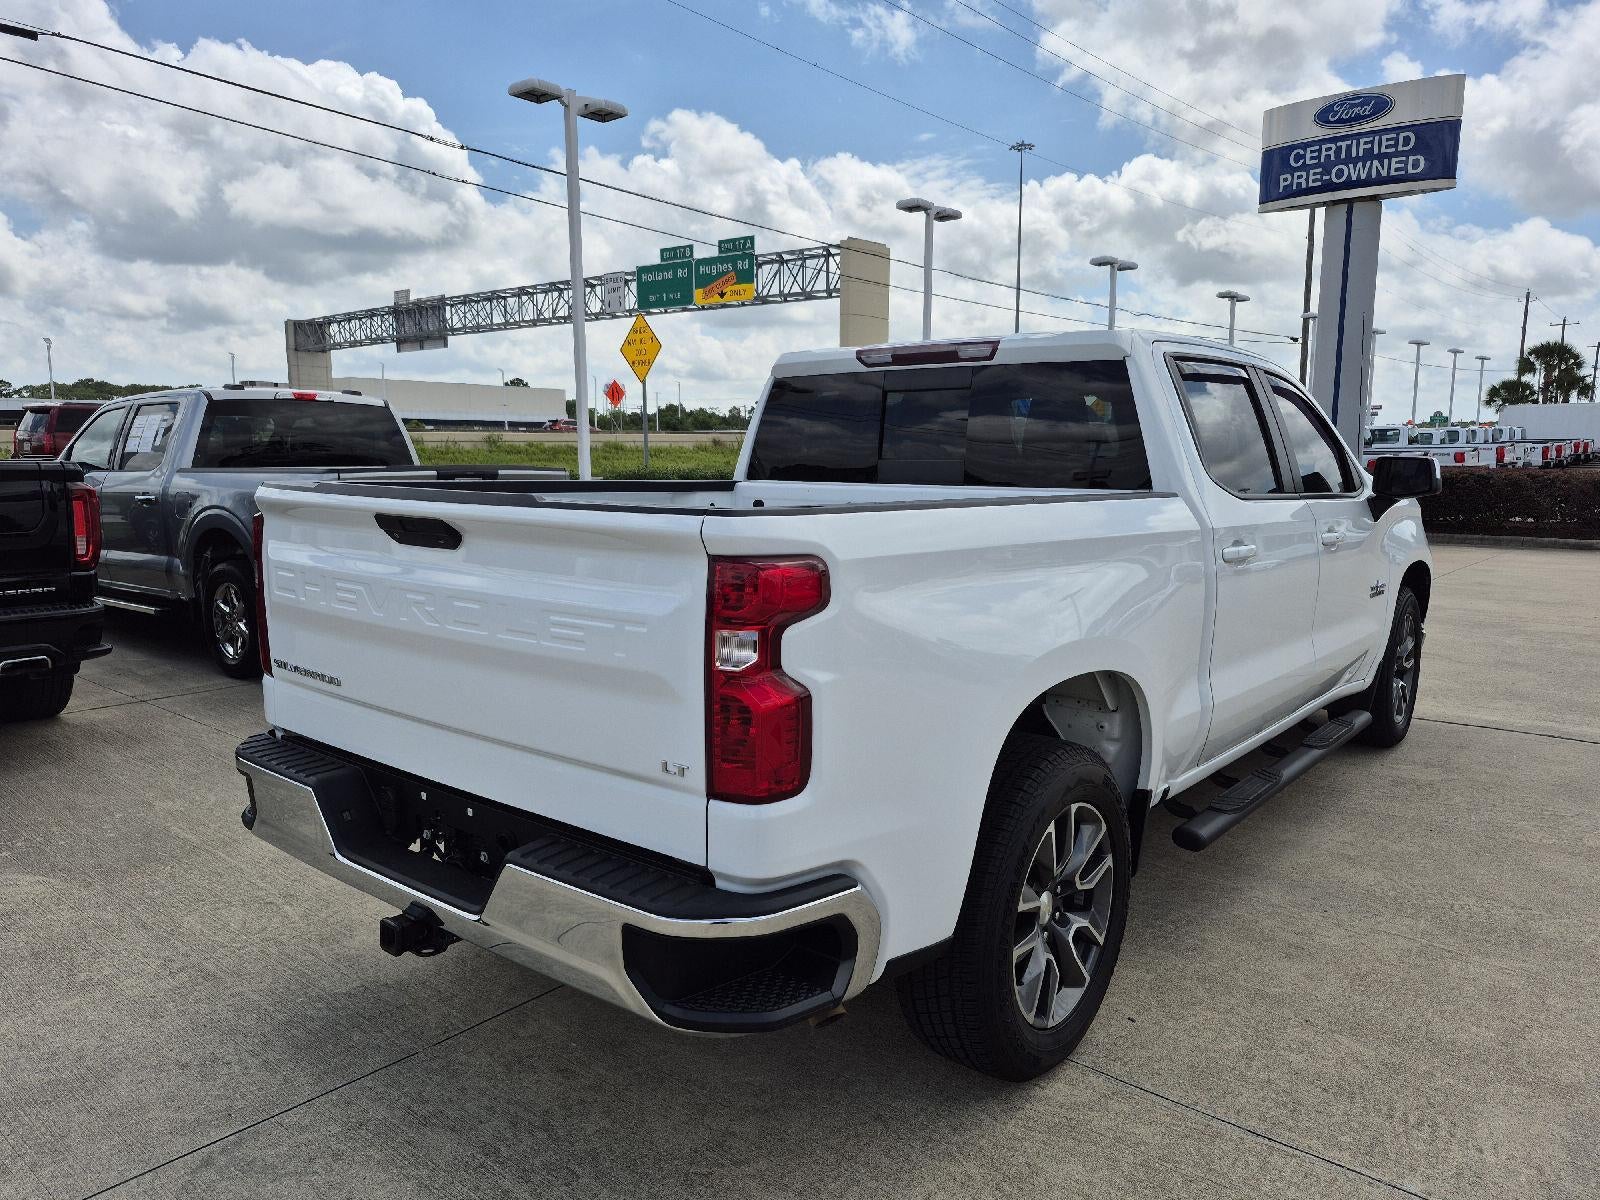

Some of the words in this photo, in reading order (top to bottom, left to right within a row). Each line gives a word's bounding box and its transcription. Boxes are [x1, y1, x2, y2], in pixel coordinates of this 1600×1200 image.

[1328, 98, 1376, 122] Ford
[1289, 131, 1416, 168] CERTIFIED
[1278, 155, 1425, 193] PRE-OWNED
[642, 269, 673, 282] Holland
[677, 268, 688, 278] Rd
[699, 262, 733, 276] Hughes
[737, 259, 749, 270] Rd
[715, 274, 735, 290] CLOSED
[729, 288, 747, 297] ONLY
[272, 566, 648, 658] CHEVROLET
[660, 759, 691, 778] LT
